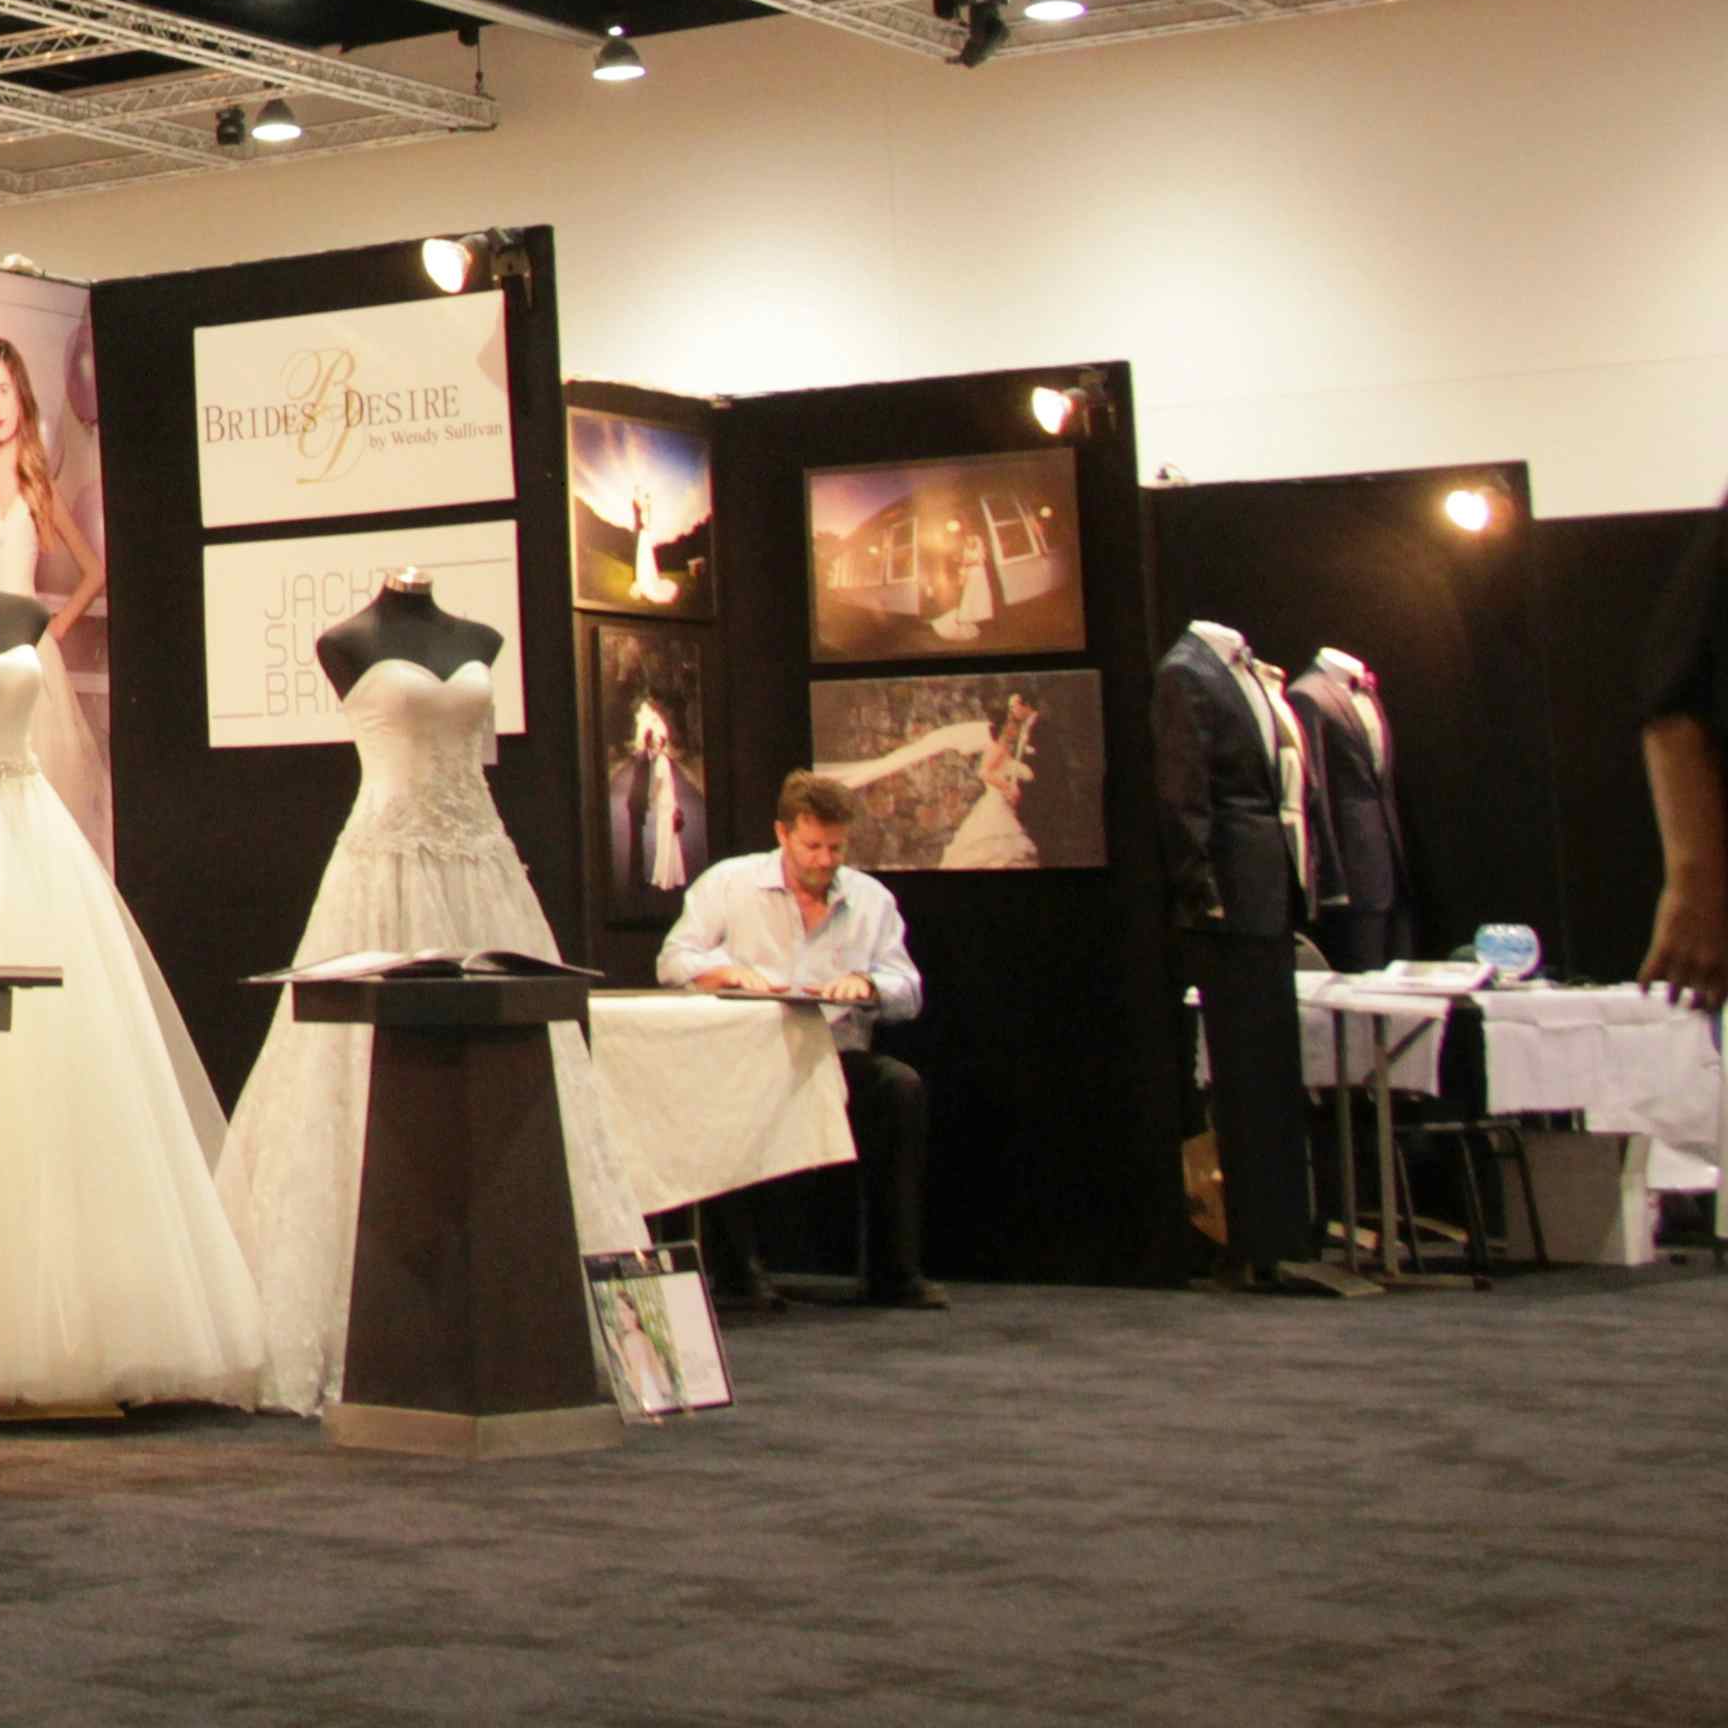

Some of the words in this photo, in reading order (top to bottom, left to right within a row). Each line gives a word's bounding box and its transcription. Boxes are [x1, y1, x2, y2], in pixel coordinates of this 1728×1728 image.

[368, 432, 386, 449] by
[391, 426, 439, 448] Wendy
[443, 420, 504, 442] Sullivan
